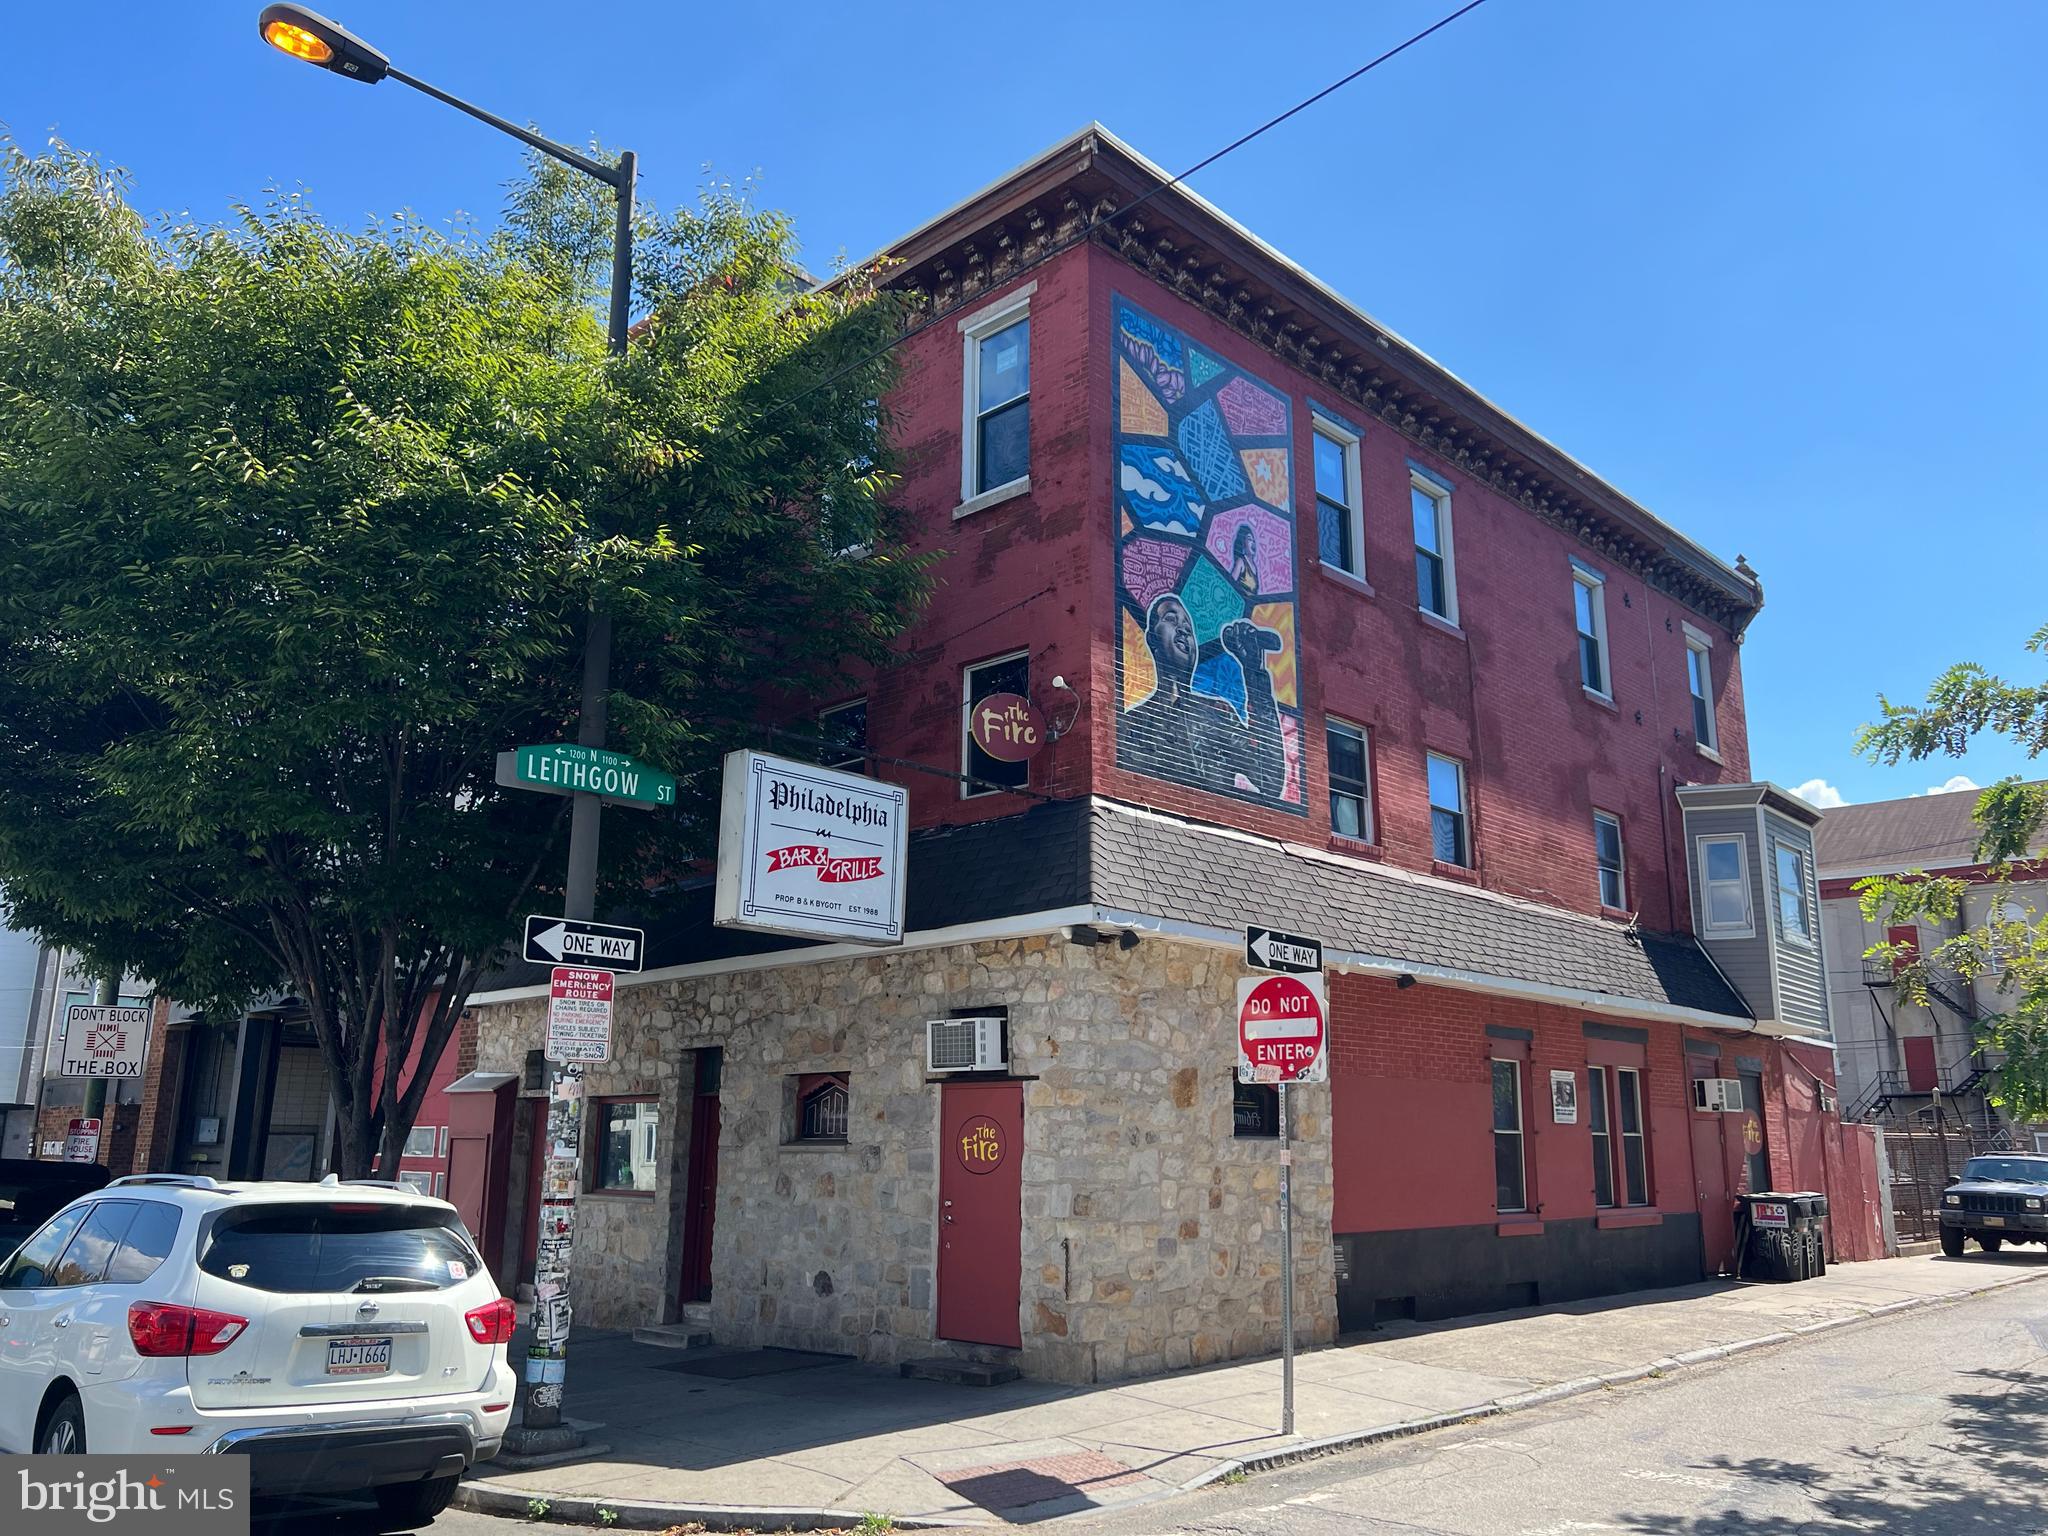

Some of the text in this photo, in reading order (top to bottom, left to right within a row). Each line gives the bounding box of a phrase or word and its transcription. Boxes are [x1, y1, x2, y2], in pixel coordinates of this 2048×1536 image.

[1007, 701, 1029, 721] The
[982, 708, 1037, 744] Fire
[569, 749, 618, 766] 1200 N 1100
[528, 754, 672, 801] LEITHGOW ST
[768, 779, 888, 827] Philadelphia
[778, 847, 877, 882] BAR & GRILLE
[796, 896, 802, 905] B
[803, 897, 809, 906] &
[848, 905, 861, 914] EST
[863, 907, 879, 916] 1988
[563, 934, 631, 958] ONE WAY
[1268, 942, 1314, 965] ONE WAY
[568, 971, 600, 981] SNOW
[553, 979, 611, 991] EMERGENCY
[565, 989, 599, 999] ROUTE
[1251, 996, 1309, 1015] DO NOT
[109, 1009, 145, 1023] BLOCK
[552, 1024, 576, 1032] VEHICLES
[1257, 1044, 1305, 1061] ENTER
[67, 1060, 138, 1075] THE BOX
[69, 1128, 97, 1136] STOPPING
[79, 1120, 91, 1130] NO
[975, 1122, 996, 1139] The
[67, 1145, 94, 1153] HOUSE
[73, 1137, 91, 1146] FIRE
[962, 1133, 999, 1161] Fire
